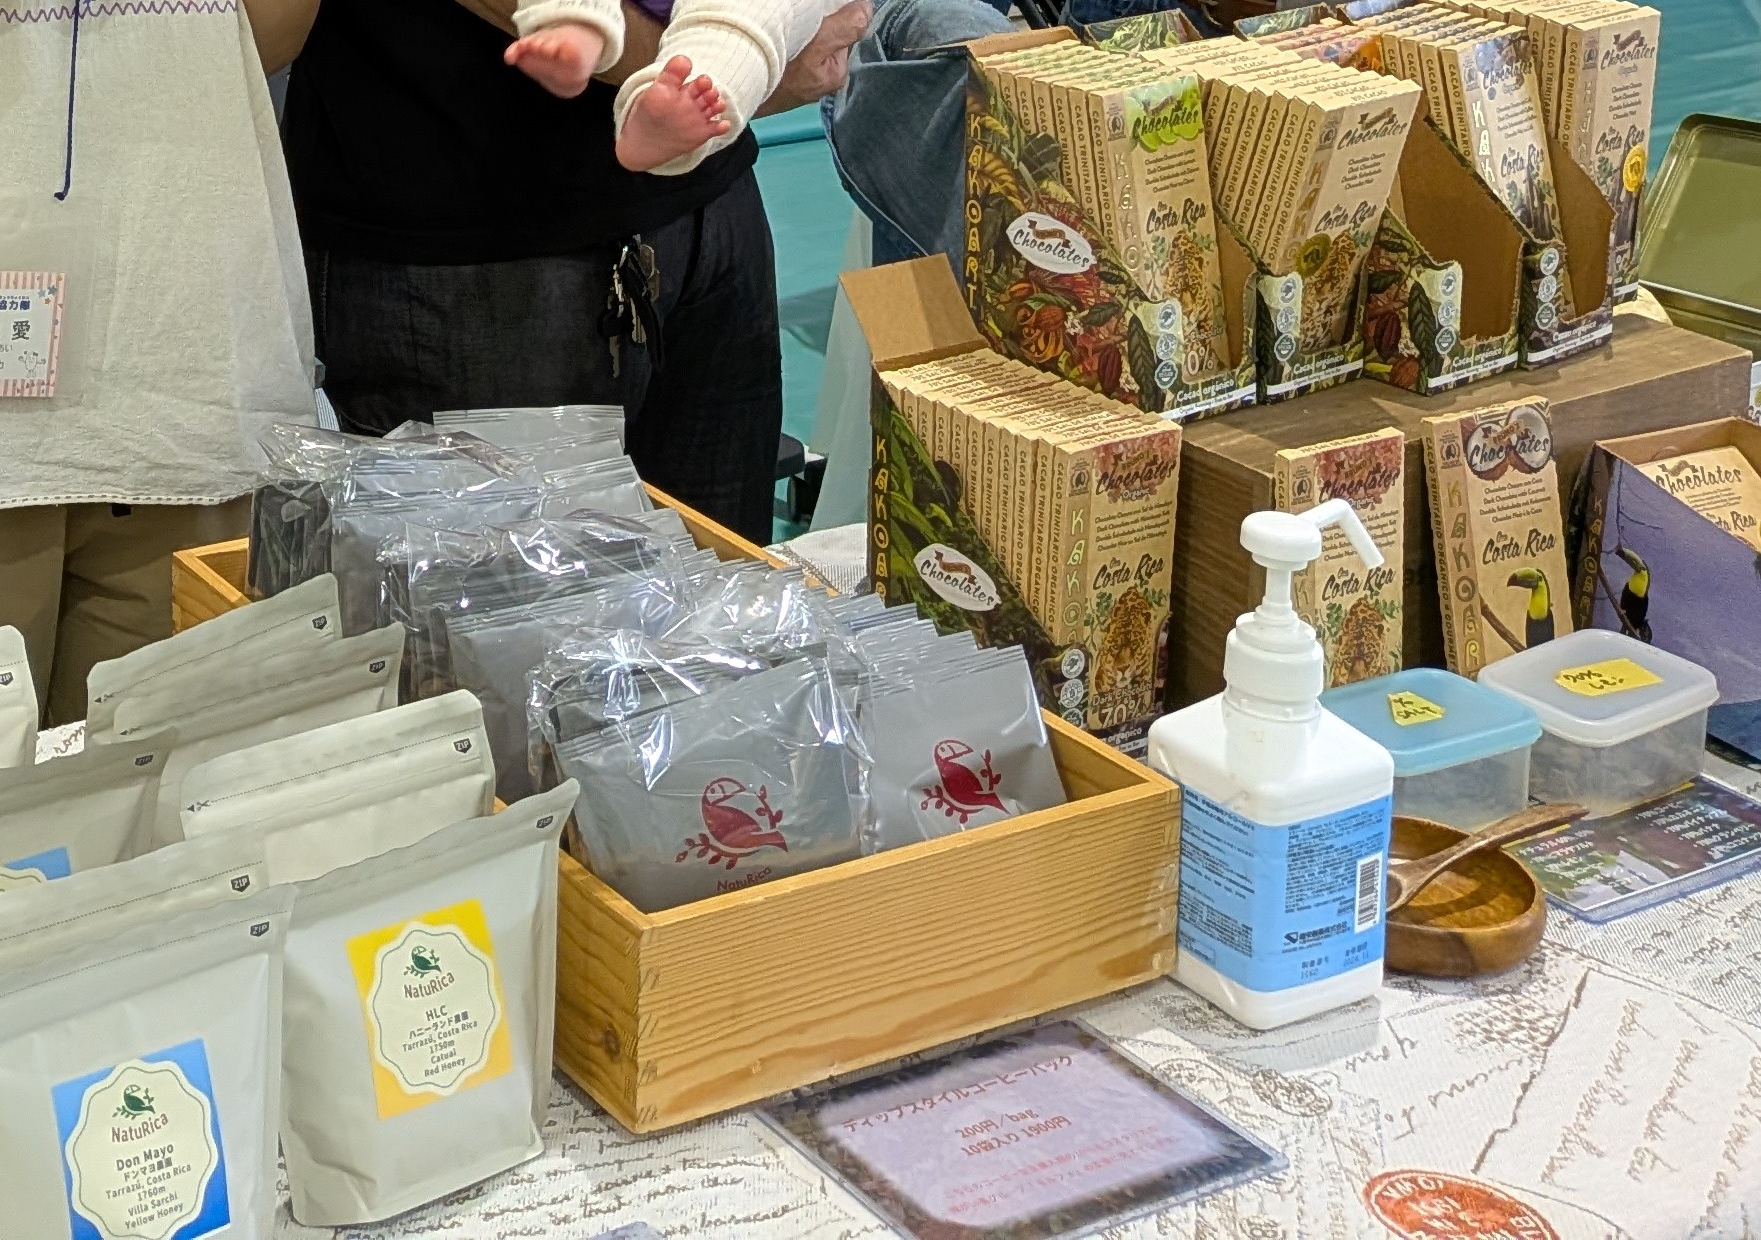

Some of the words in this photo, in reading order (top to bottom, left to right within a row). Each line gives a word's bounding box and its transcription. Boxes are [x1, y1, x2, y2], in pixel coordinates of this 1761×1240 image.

[1600, 42, 1655, 71] Chocolates
[1425, 58, 1438, 94] CACAO
[1448, 63, 1461, 98] CACAO
[1055, 97, 1067, 134] CACAO
[1074, 105, 1085, 143] CACAO
[1132, 107, 1199, 141] Chocolates
[1224, 101, 1238, 135] CACAO
[1243, 105, 1259, 140] CACAO
[1264, 108, 1279, 142] CACAO
[1283, 113, 1299, 147] CACAO
[1454, 101, 1471, 157] TRINITARIO
[1301, 119, 1317, 154] CACAO
[1337, 115, 1409, 151] Chocolates
[1595, 131, 1623, 155] Costa
[1079, 144, 1093, 210] TRINITARIO
[1097, 149, 1111, 211] TRINITARIO
[1227, 139, 1248, 193] TRINITARIO
[1248, 143, 1267, 198] TRINITARIO
[1268, 148, 1288, 203] TRINITARIO
[1286, 156, 1305, 209] TRINITARIO
[966, 113, 983, 309] KAKOART
[1146, 206, 1180, 235] Costa
[1181, 197, 1207, 225] Rica
[1314, 209, 1352, 234] Costa
[1349, 200, 1378, 229] Rica
[1013, 229, 1089, 268] Chocolates
[11, 320, 31, 341] 愛
[1187, 344, 1215, 377] 0%
[1176, 390, 1202, 403] Cacao
[1096, 459, 1177, 496] Chocolates
[1319, 467, 1401, 504] Chocolates
[999, 481, 1009, 542] TRINITARIO
[1730, 510, 1757, 532] Rica
[1482, 536, 1522, 565] Costa
[1524, 528, 1556, 558] Rica
[920, 559, 995, 607] Chocolates
[1093, 561, 1132, 591] Costa
[1134, 553, 1165, 582] Rica
[1321, 573, 1364, 602] Costa
[1092, 690, 1114, 706] Dark
[1101, 697, 1142, 729] 70%
[455, 739, 470, 750] ZIP
[233, 876, 249, 888] ZIP
[716, 866, 773, 892] NatuRica
[403, 971, 455, 999] NatuRica
[425, 1004, 448, 1022] HLC
[437, 1026, 460, 1040] Costa
[461, 1020, 478, 1032] Rica
[424, 1065, 439, 1077] Red
[441, 1057, 466, 1071] Honey
[111, 1113, 169, 1143] NatuRica
[115, 1155, 141, 1172] Don
[143, 1144, 174, 1162] Mayo
[146, 1171, 172, 1186] Costa
[172, 1163, 192, 1176] Rica
[128, 1203, 149, 1217] Villa
[137, 1186, 166, 1202] 1760m
[125, 1213, 155, 1230] Yellow
[157, 1202, 184, 1219] Honey
